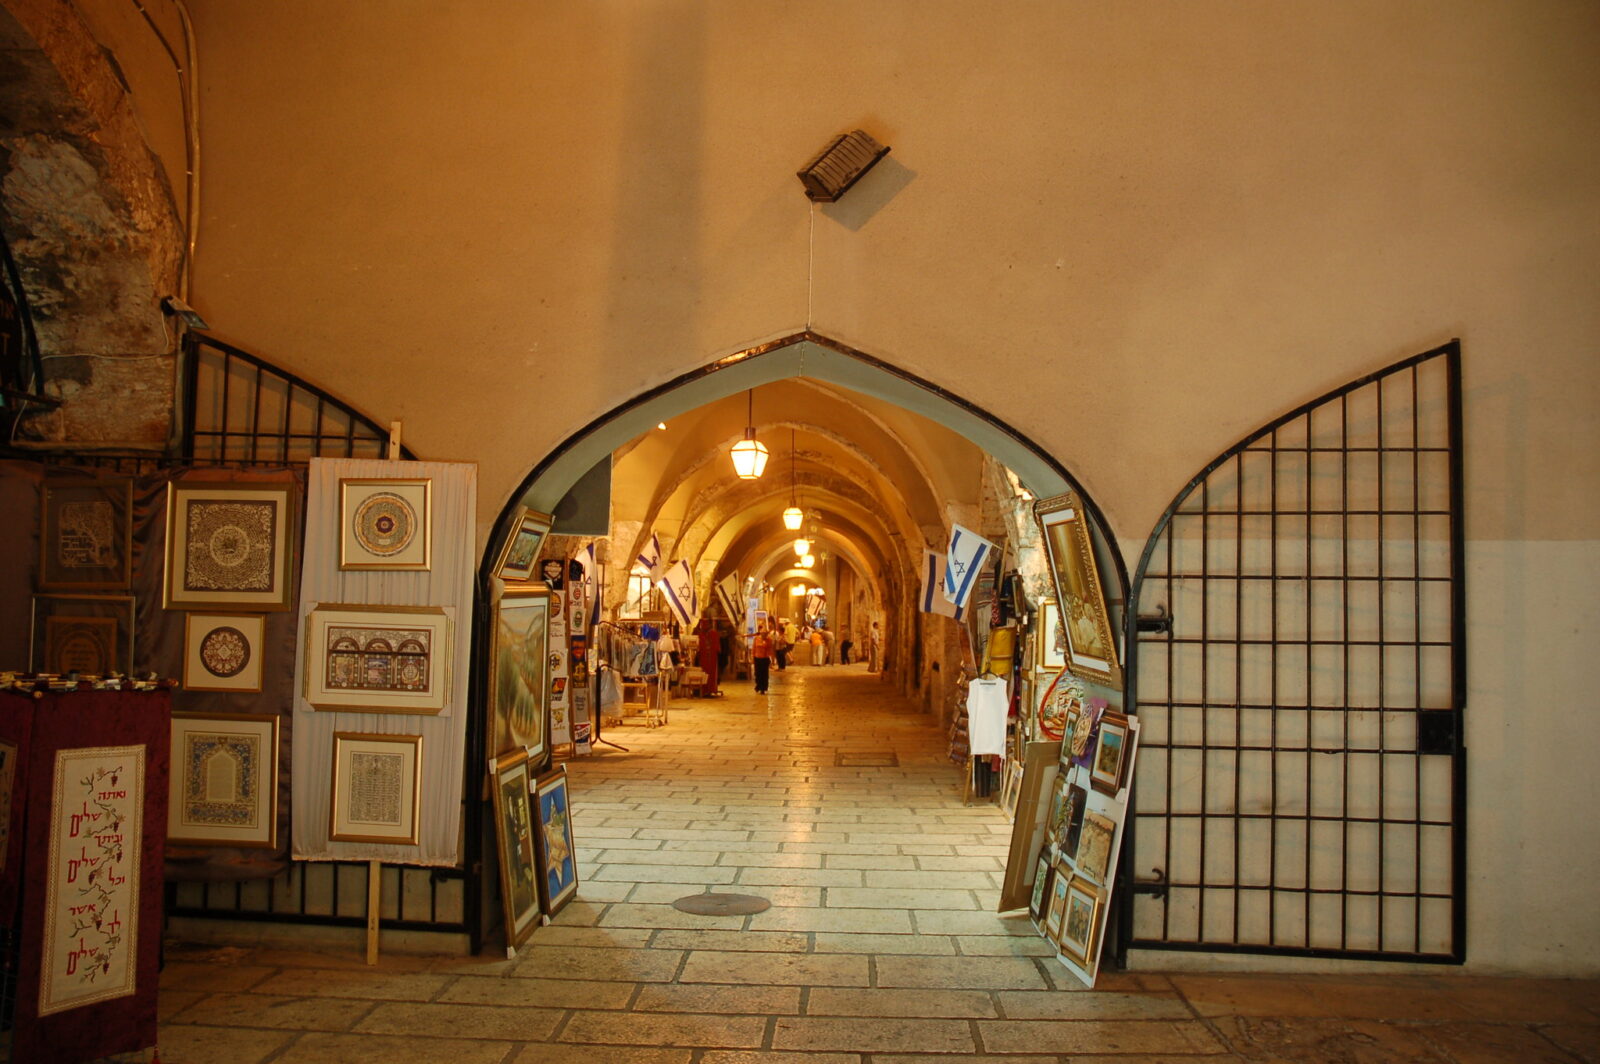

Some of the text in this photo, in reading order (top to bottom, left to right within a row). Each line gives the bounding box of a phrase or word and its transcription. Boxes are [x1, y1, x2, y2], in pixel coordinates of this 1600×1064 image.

[98, 790, 126, 801] ואתה
[69, 801, 103, 838] שלום
[94, 834, 123, 847] וביתך
[67, 846, 100, 884] שלום
[108, 866, 126, 885] וכל
[68, 903, 97, 916] אשר
[66, 937, 99, 976] שלום
